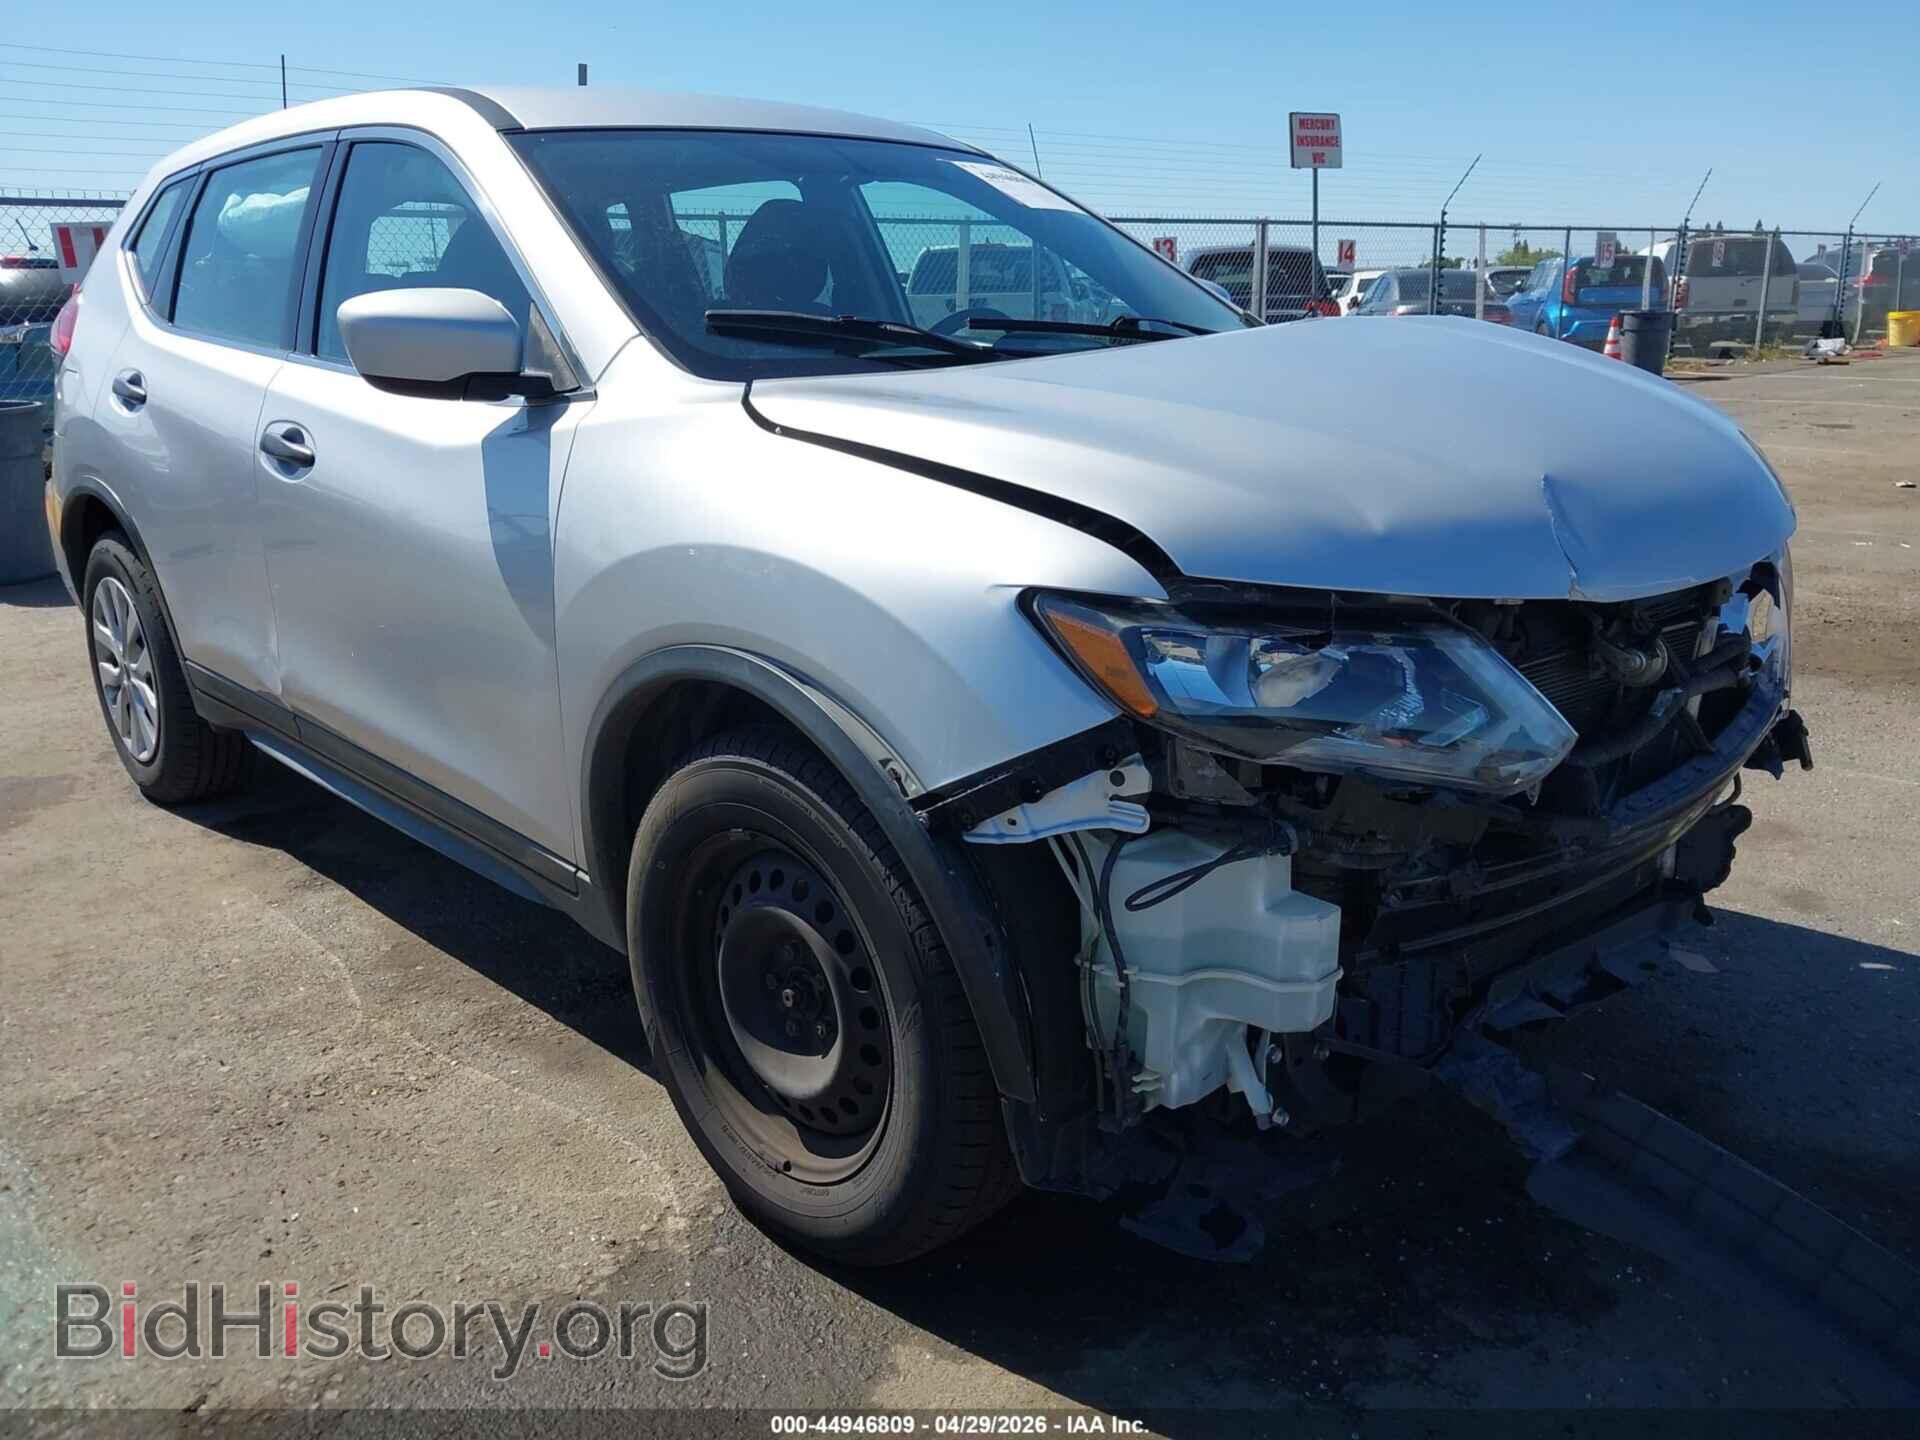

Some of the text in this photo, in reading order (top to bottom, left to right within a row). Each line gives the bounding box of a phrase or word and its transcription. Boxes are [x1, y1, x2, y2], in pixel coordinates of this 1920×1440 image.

[1298, 118, 1335, 130] MERCURY
[1295, 135, 1340, 148] INSURANCE
[1339, 240, 1355, 264] 14
